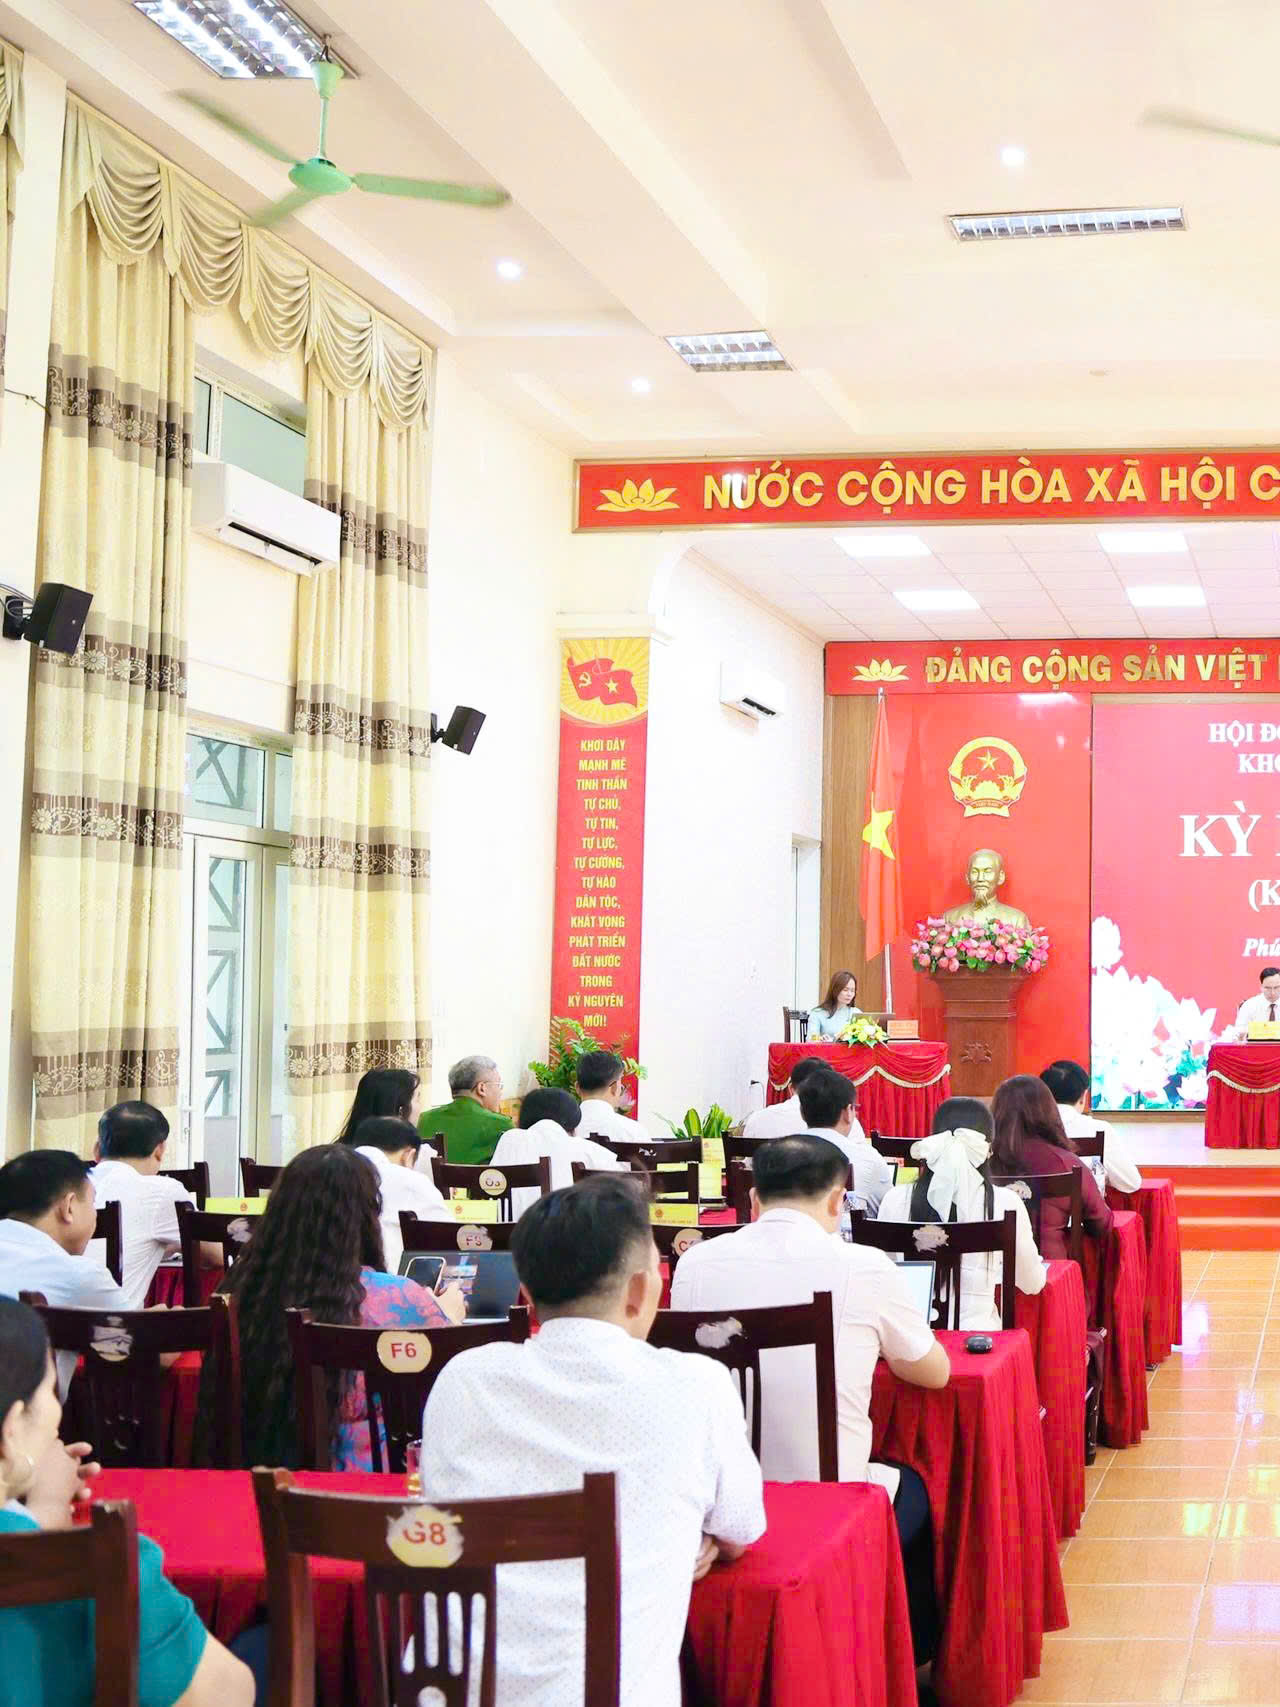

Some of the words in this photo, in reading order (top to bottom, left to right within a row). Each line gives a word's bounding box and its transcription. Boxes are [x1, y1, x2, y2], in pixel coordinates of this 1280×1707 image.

[703, 459, 825, 511] NƯỚC
[837, 460, 965, 514] CỘNG
[982, 456, 1072, 506] HÒA
[1085, 457, 1147, 505] XÃ
[1161, 455, 1235, 510] HỘI
[925, 646, 1011, 684] ĐẢNG
[1022, 647, 1112, 690] CỘNG
[1123, 644, 1186, 682] SẢN
[1195, 646, 1268, 689] VIỆT
[1209, 720, 1254, 747] HỘI
[577, 778, 598, 790] TINH
[584, 798, 596, 812] TỰ
[585, 818, 597, 832] TỰ
[1179, 801, 1263, 857] KỲ
[582, 837, 595, 851] TỰ
[574, 857, 587, 871] TỰ
[582, 876, 595, 891] TỰ
[1244, 937, 1280, 958] Phú
[580, 976, 612, 987] TRONG
[391, 1342, 416, 1358] F6
[402, 1521, 445, 1545] G8
